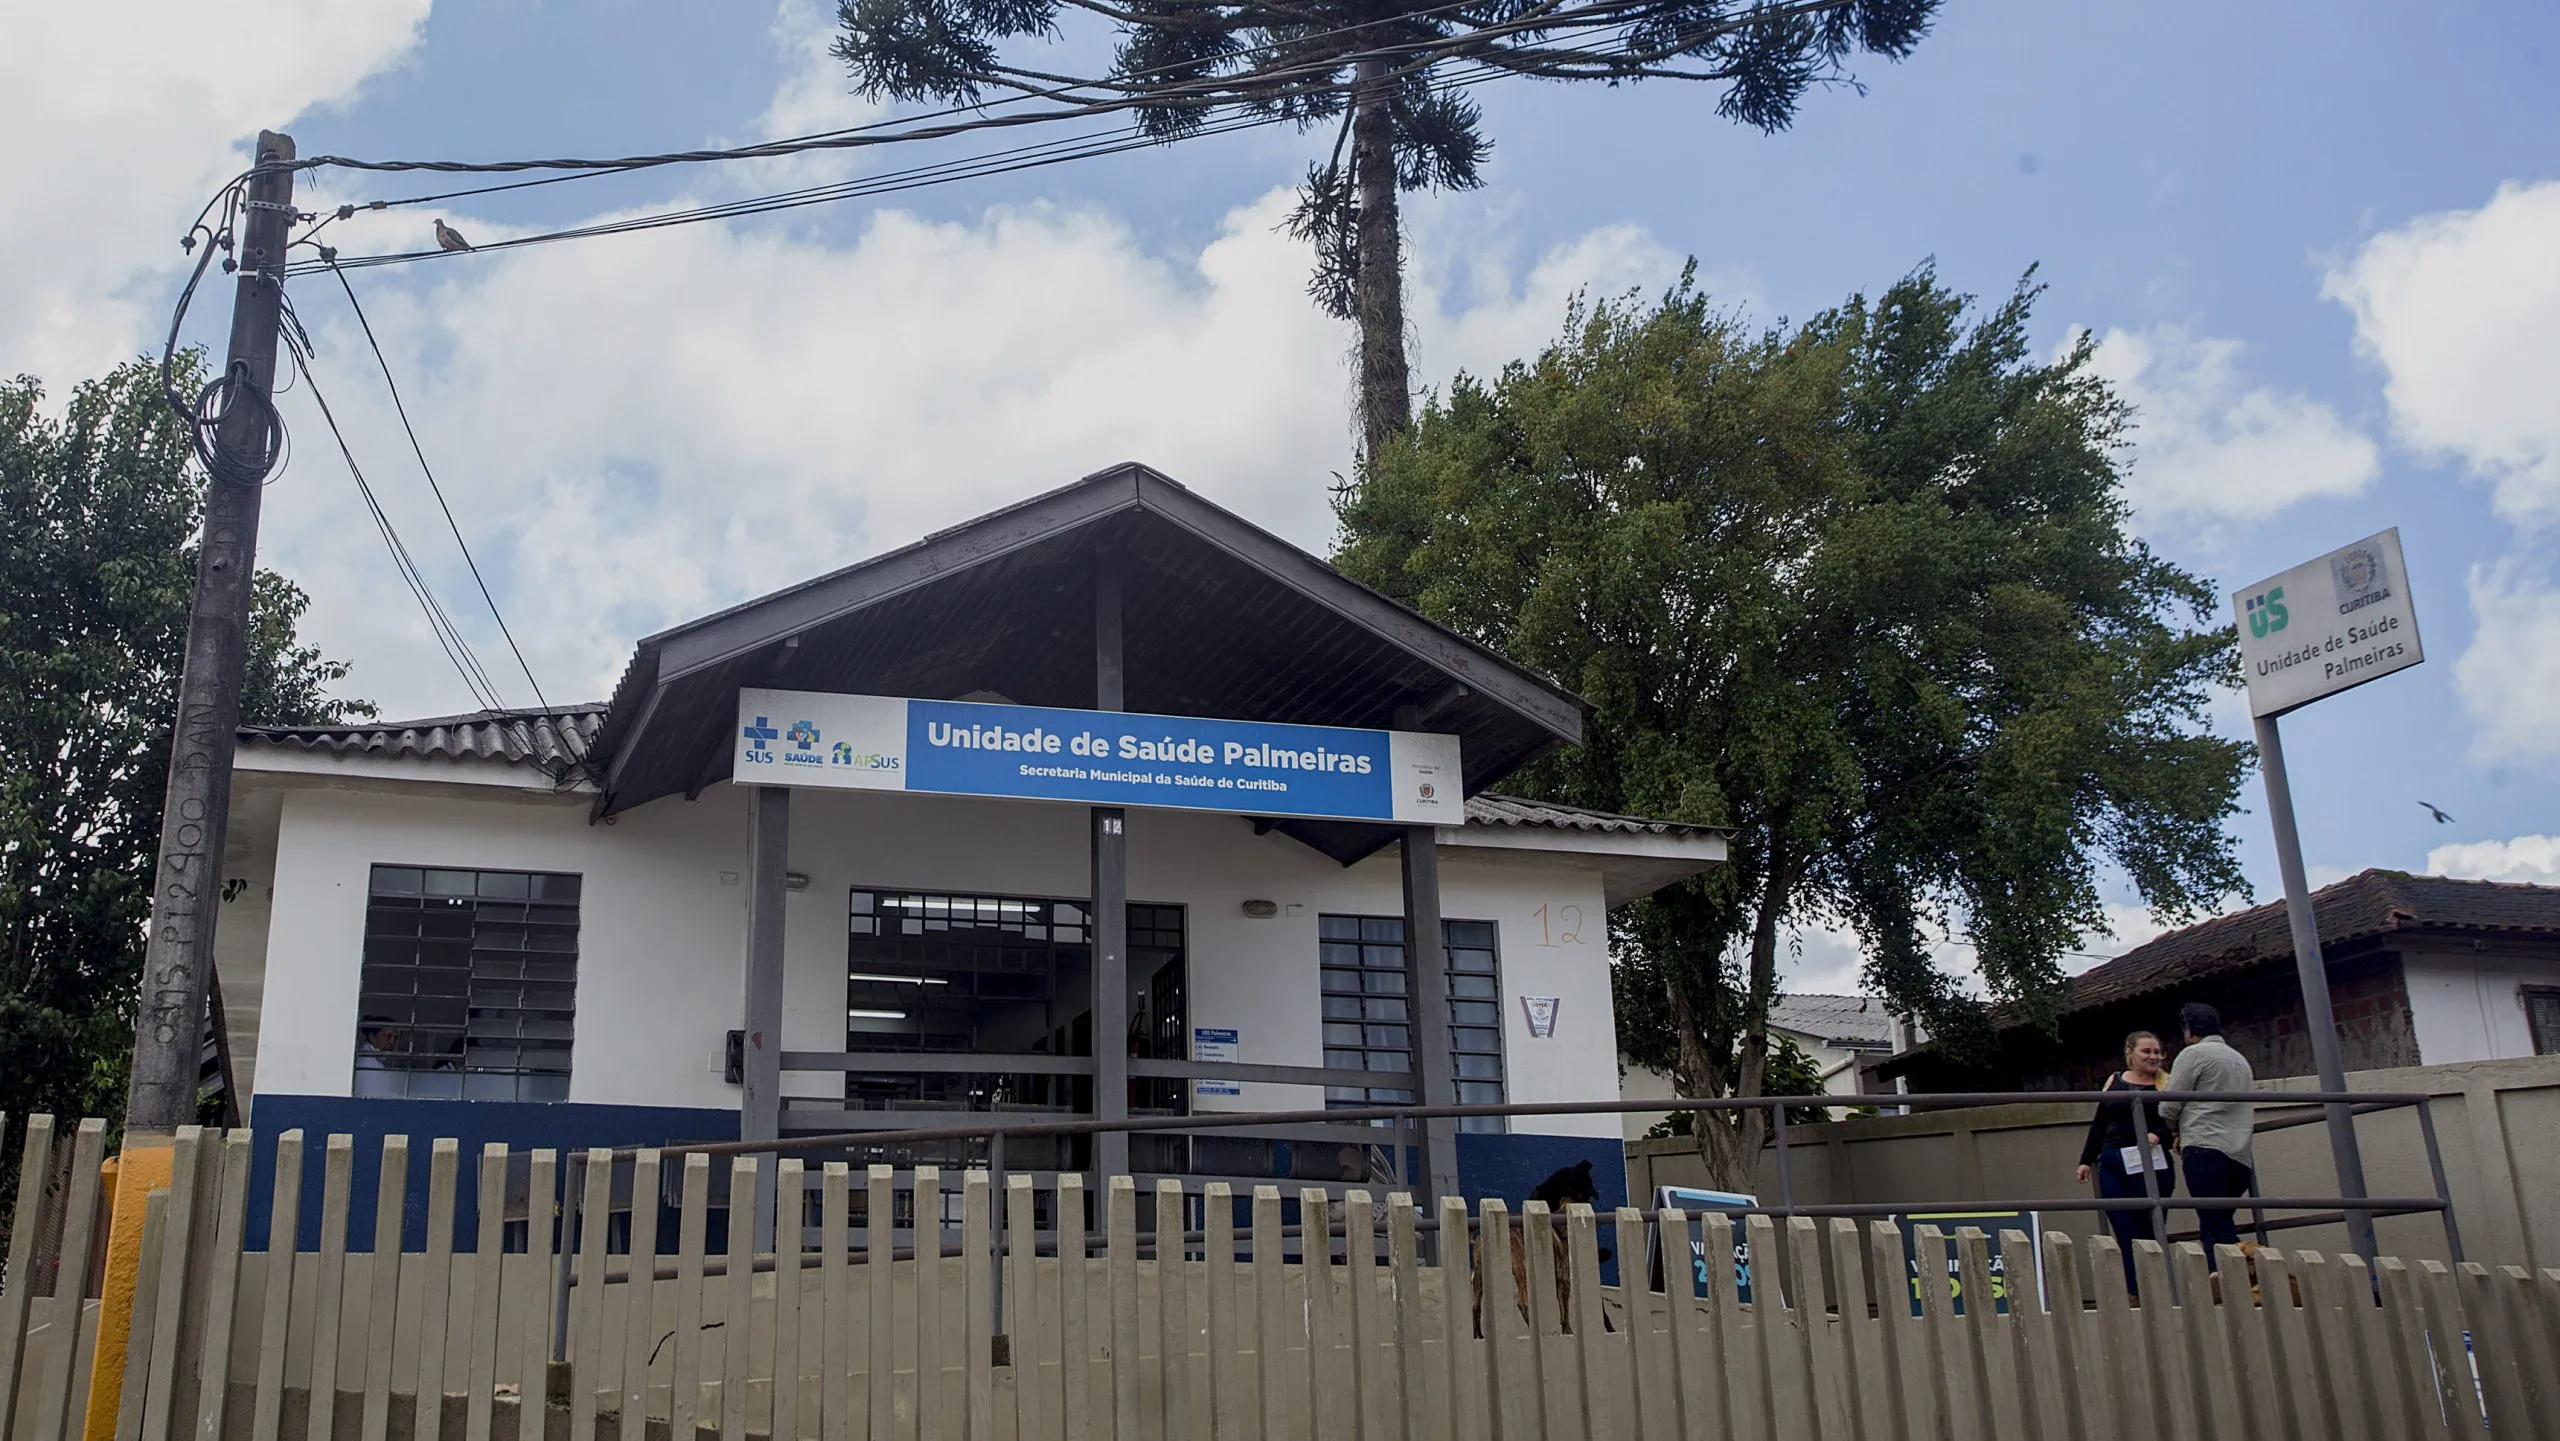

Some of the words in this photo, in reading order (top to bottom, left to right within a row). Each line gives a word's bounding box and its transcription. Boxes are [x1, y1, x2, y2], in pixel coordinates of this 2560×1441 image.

[2338, 587, 2392, 616] CURITIBA
[2256, 644, 2321, 677] Unidade
[2324, 634, 2344, 653] de
[2347, 615, 2399, 645] Saúde
[2324, 641, 2404, 680] Palmeiras
[745, 750, 774, 764] SUS
[784, 751, 824, 764] SAÚDE
[928, 721, 1062, 754] Unidade
[1070, 731, 1110, 758] de
[1118, 735, 1215, 765] Saúde
[1224, 741, 1372, 775] Palmeiras
[1019, 764, 1087, 780] Secretaria
[1090, 769, 1152, 785] Municipal
[1155, 773, 1172, 785] da
[1174, 774, 1214, 788] Saúde
[1217, 776, 1234, 788] de
[1237, 778, 1288, 792] Curitiba
[1532, 903, 1586, 948] 12
